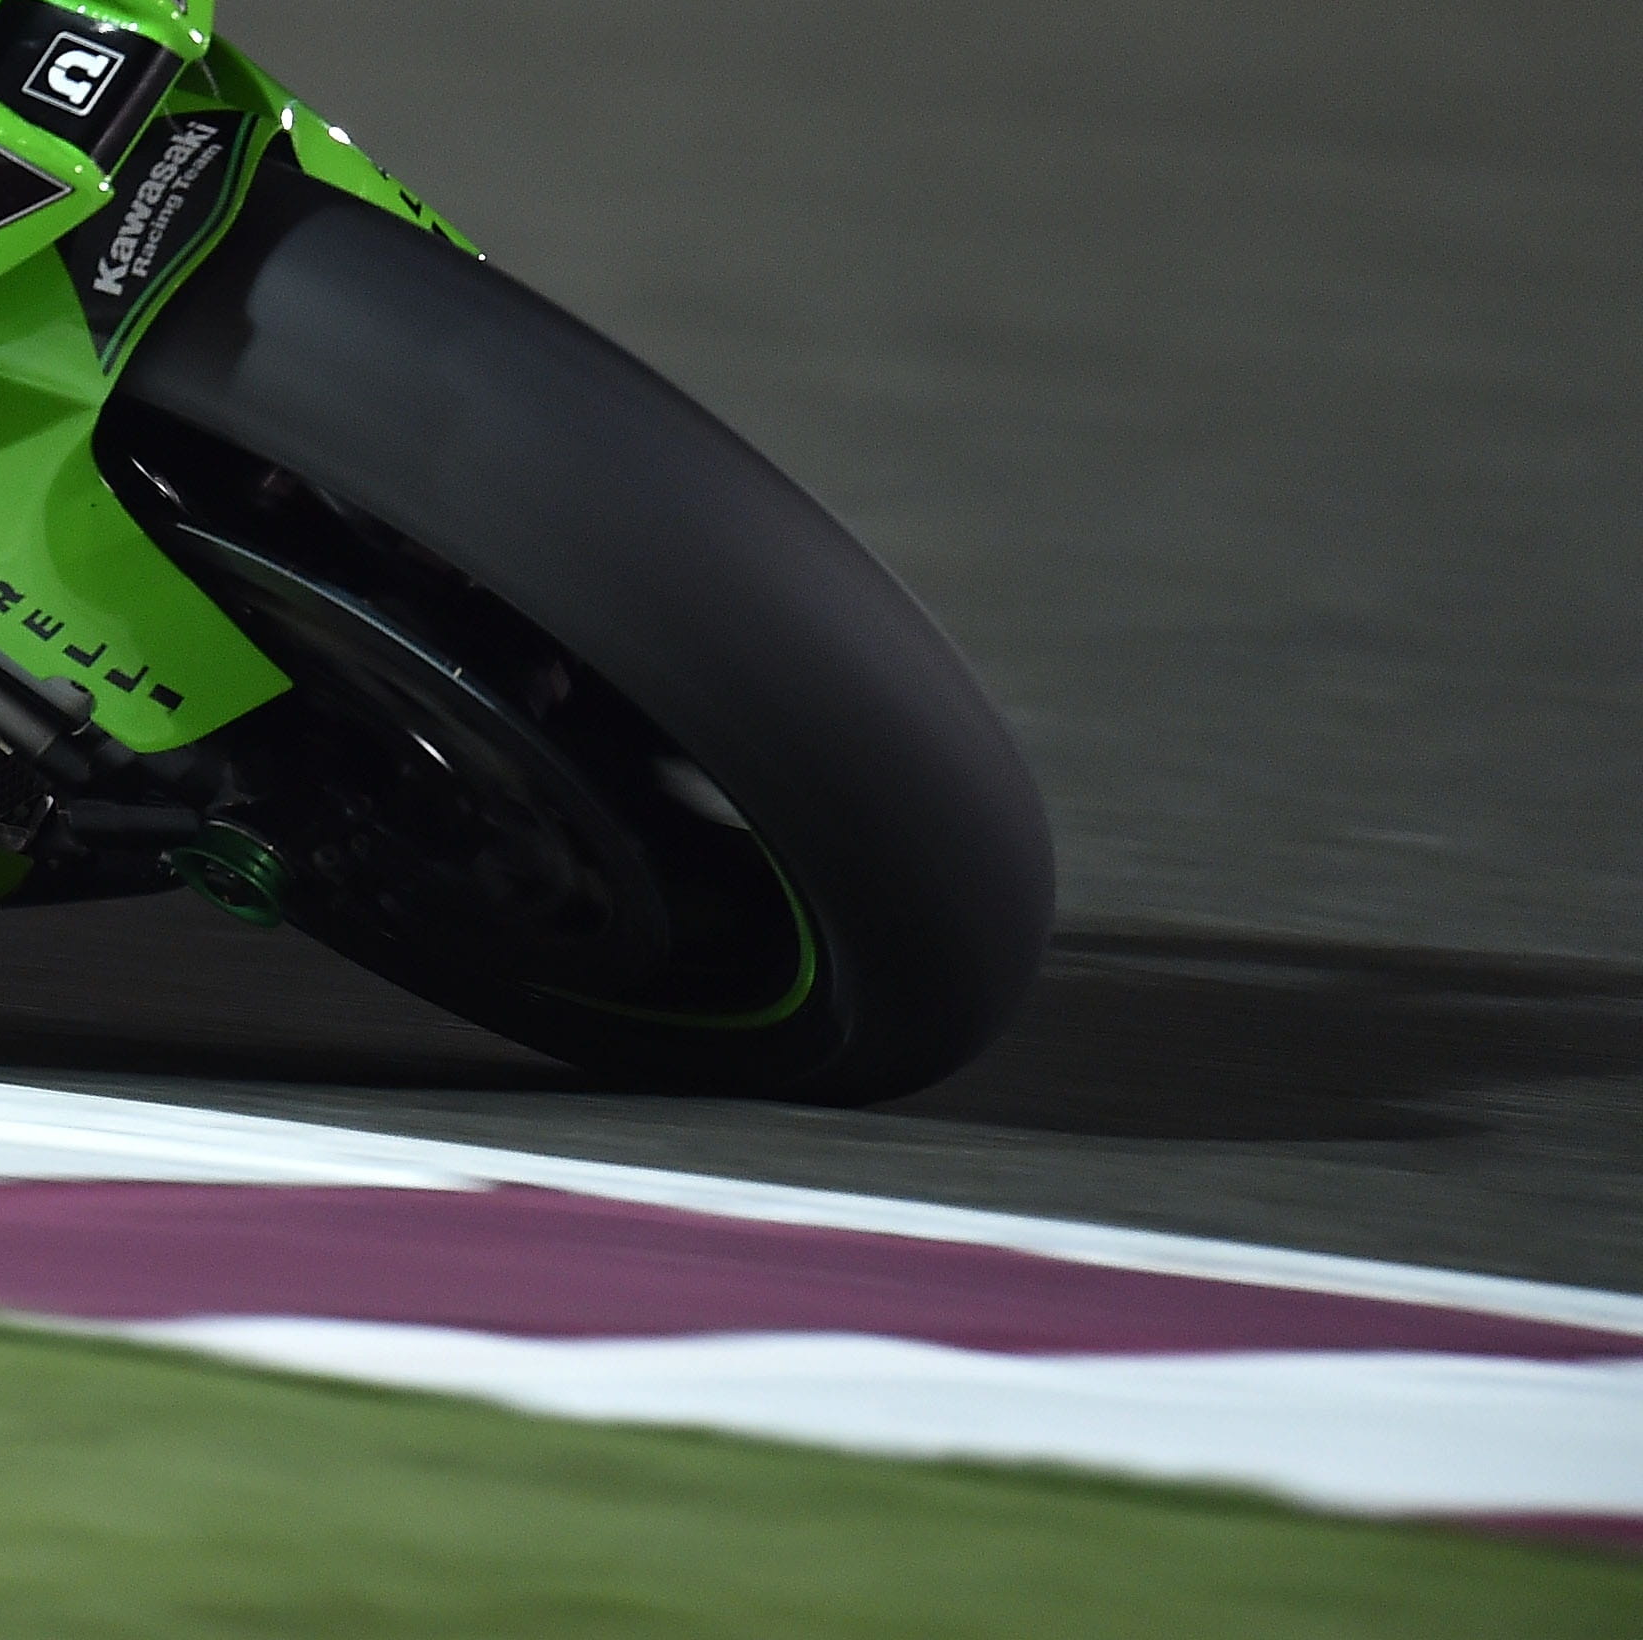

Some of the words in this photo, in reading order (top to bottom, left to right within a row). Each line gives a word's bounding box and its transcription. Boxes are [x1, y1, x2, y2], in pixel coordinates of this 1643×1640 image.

[92, 121, 219, 296] Kawasaki
[131, 194, 184, 277] Racing
[171, 144, 223, 190] Team
